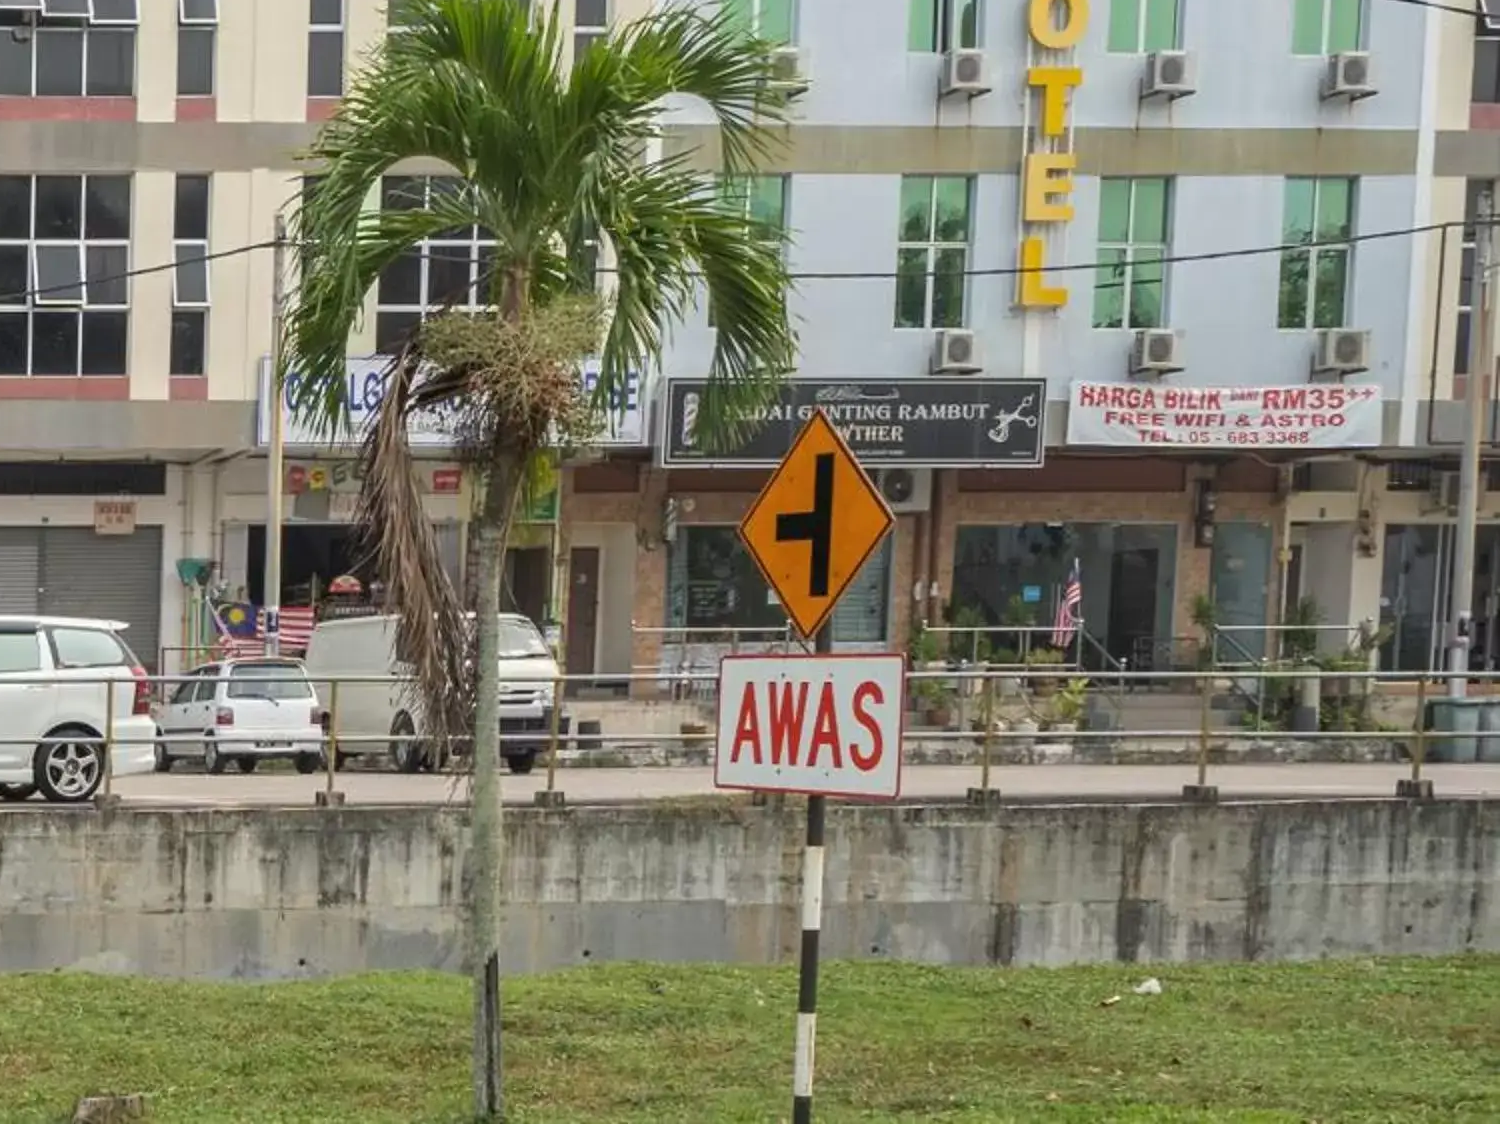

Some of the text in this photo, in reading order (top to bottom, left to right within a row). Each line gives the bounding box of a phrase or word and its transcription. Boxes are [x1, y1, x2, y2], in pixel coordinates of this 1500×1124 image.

[1079, 385, 1157, 409] HARGA
[1163, 389, 1222, 410] BILIK
[898, 402, 991, 421] RAMBUT
[1104, 411, 1346, 427] FREE WIFI & ASTRO
[730, 680, 885, 772] AWAS
